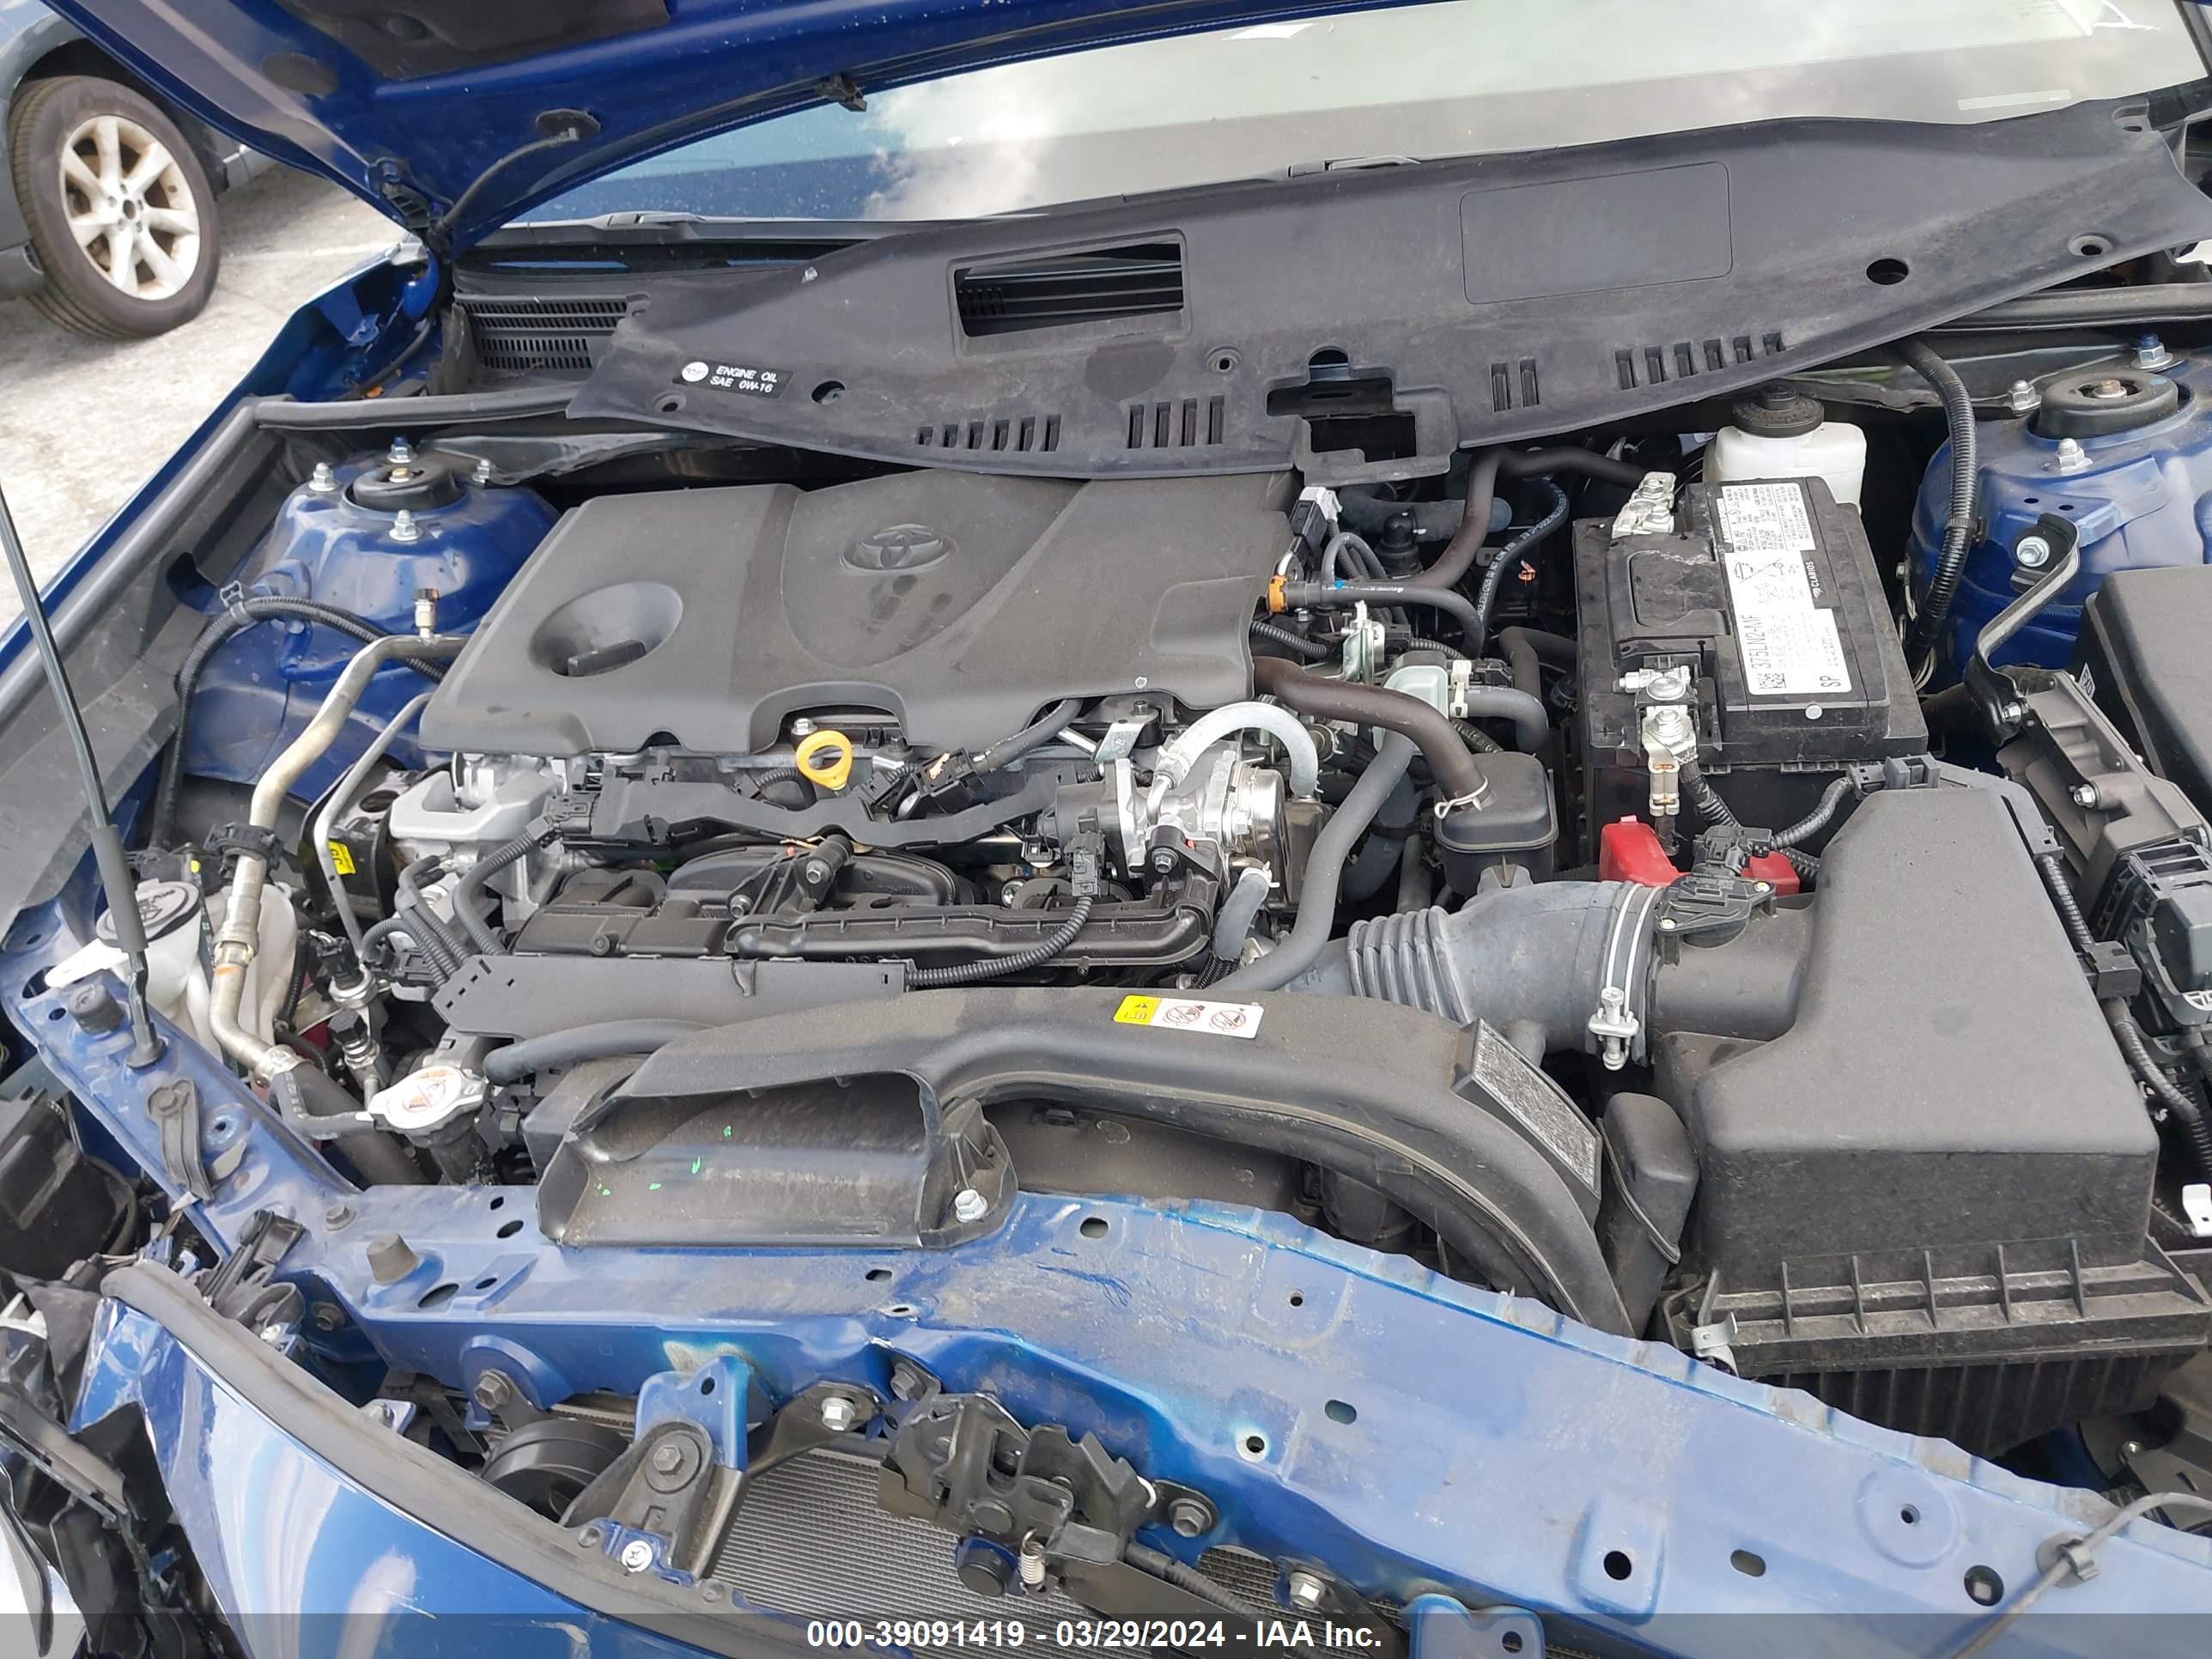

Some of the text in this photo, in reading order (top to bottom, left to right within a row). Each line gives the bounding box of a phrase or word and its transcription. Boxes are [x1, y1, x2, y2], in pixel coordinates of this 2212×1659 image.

[715, 366, 778, 383] ENGINE OIL
[709, 375, 774, 393] SAE 0W-16
[1805, 561, 1820, 587] CLARIOS
[1741, 614, 1771, 669] 375LN2-MF
[1819, 675, 1842, 688] SP
